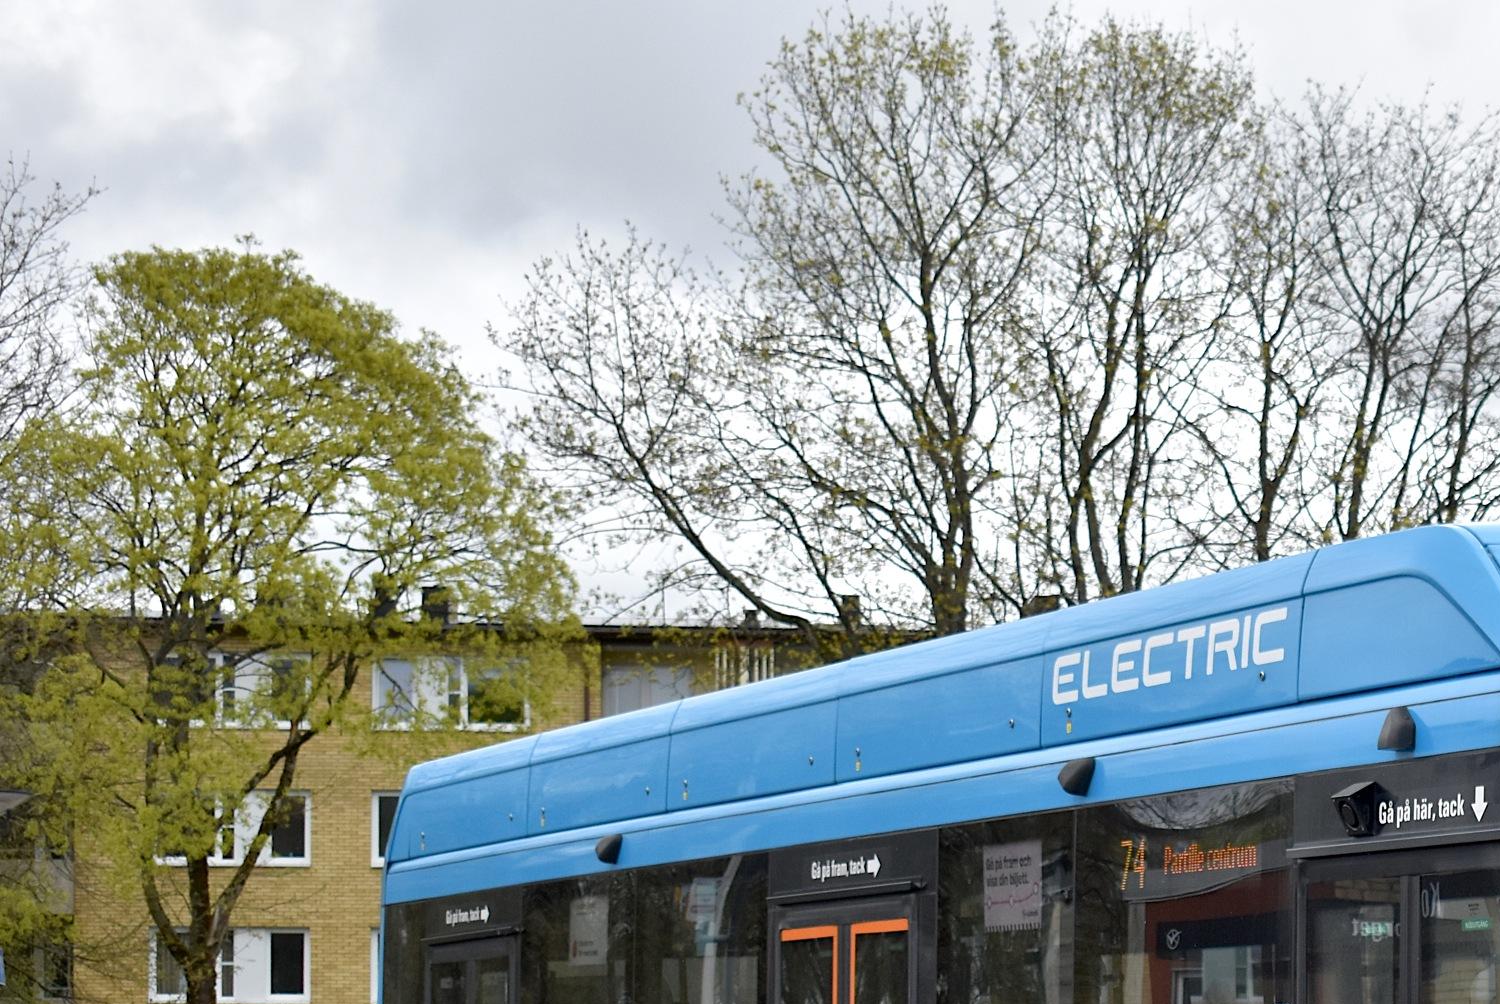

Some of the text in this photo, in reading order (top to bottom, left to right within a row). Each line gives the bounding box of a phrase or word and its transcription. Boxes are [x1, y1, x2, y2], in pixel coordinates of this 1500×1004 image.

[1052, 607, 1288, 706] ELECTRIC
[1378, 793, 1465, 829] Gå på här, tack
[849, 856, 866, 875] tack
[1120, 837, 1257, 891] 74 Partille centrum
